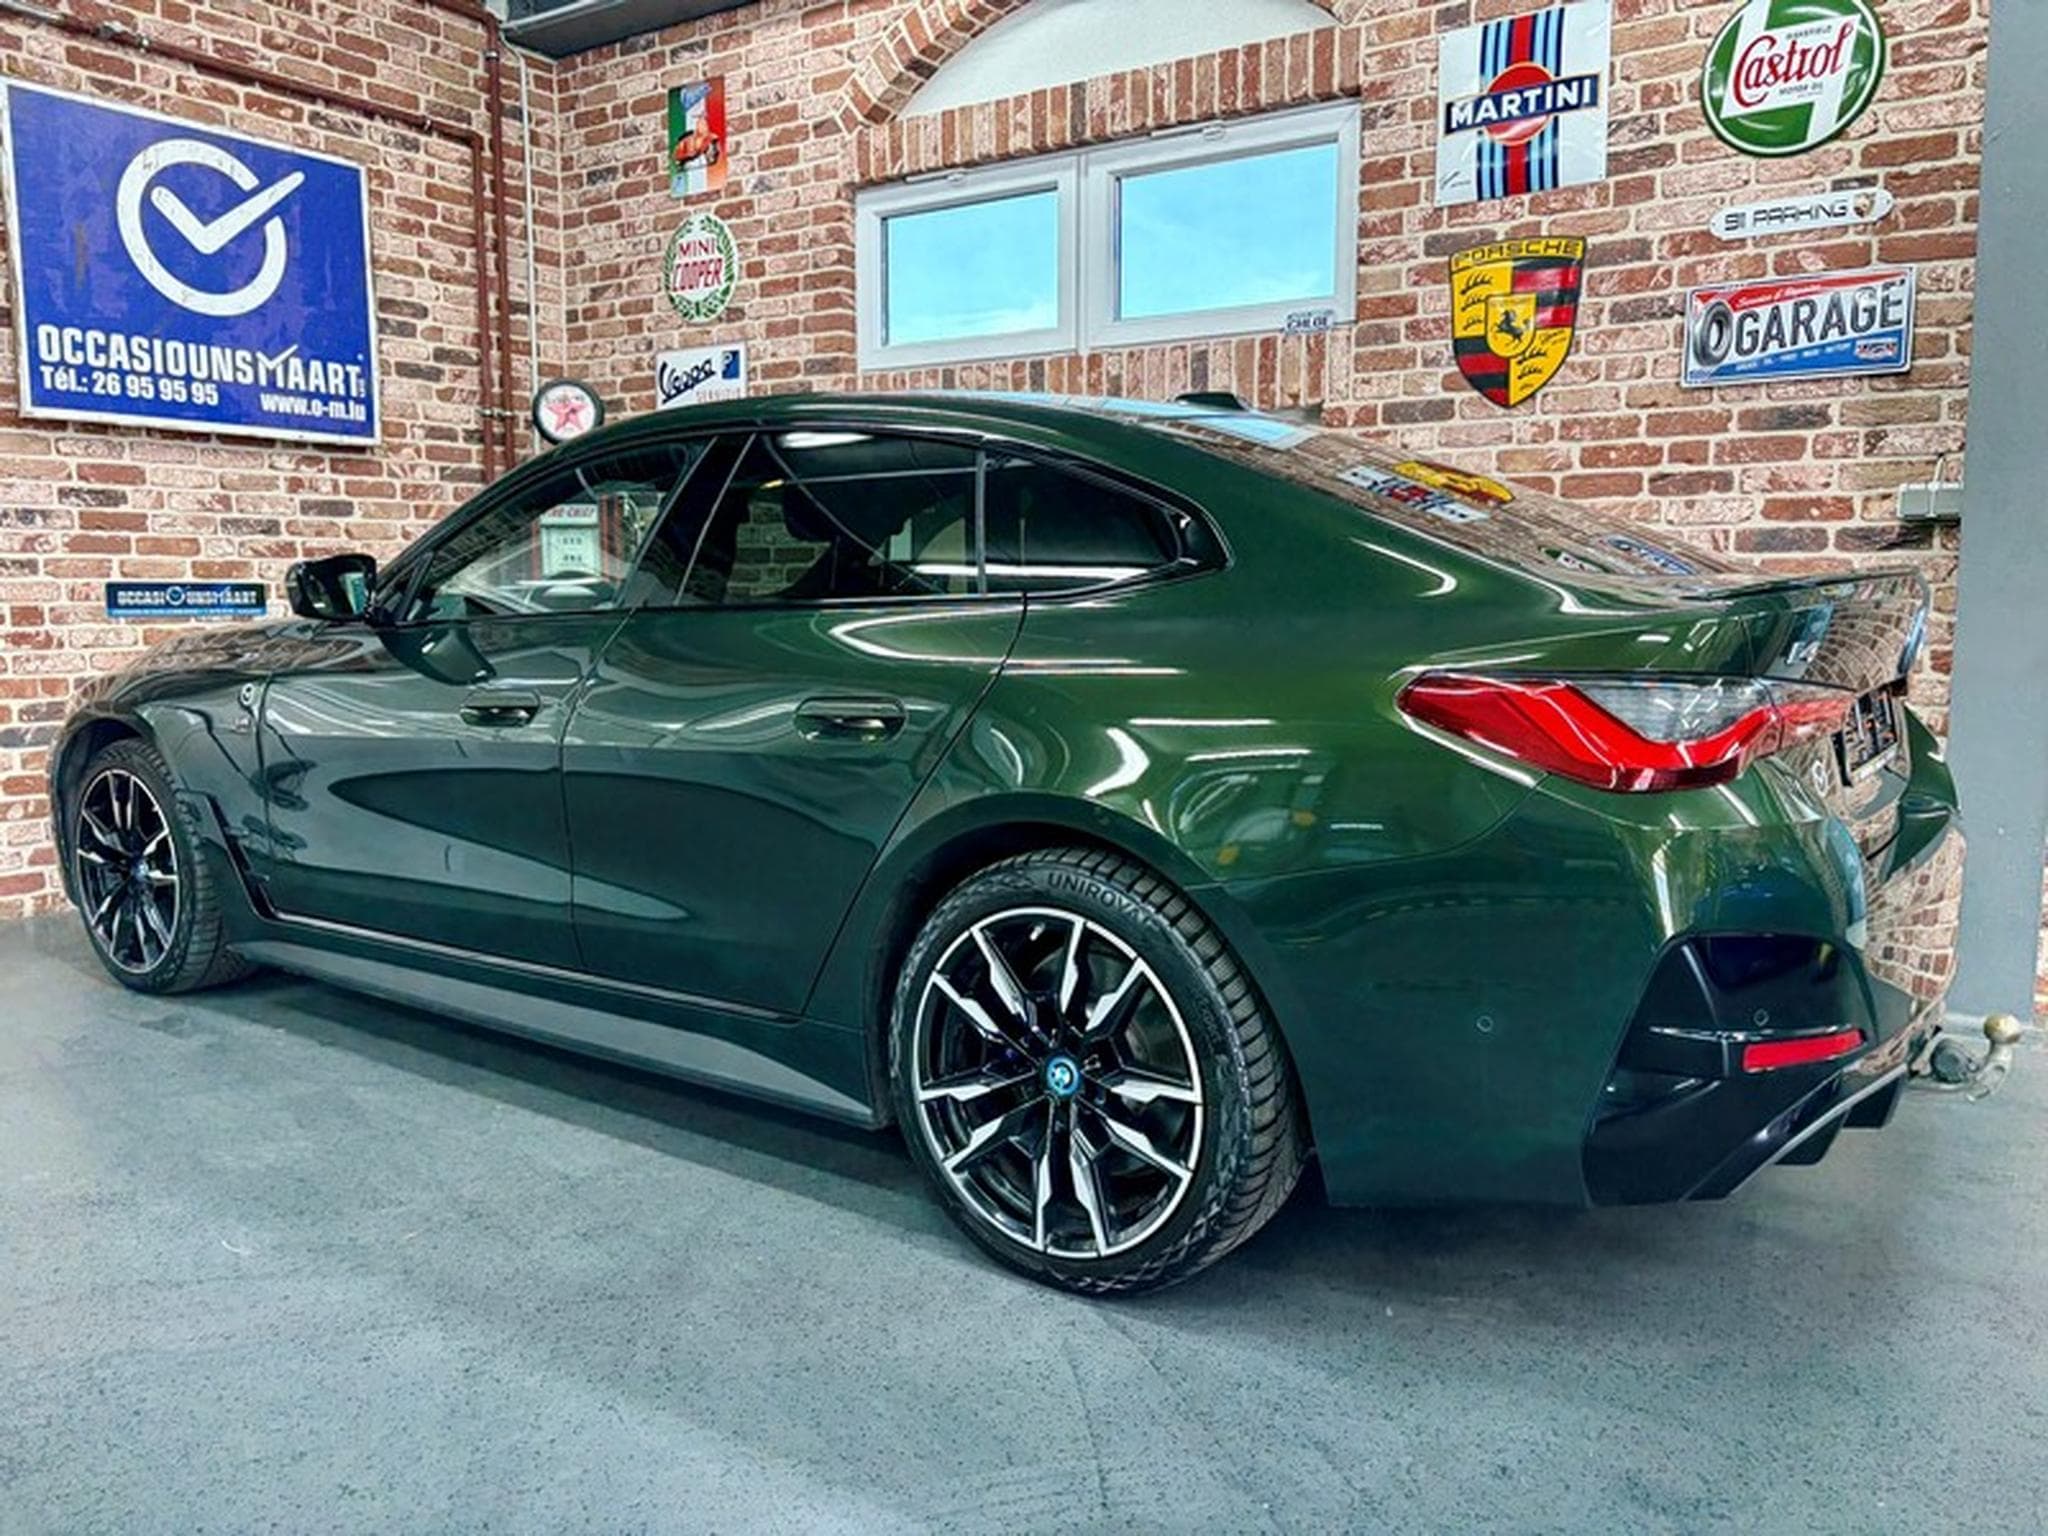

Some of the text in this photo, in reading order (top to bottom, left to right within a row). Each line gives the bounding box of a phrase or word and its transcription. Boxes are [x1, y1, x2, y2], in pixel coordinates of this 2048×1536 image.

[1732, 21, 1854, 108] Castrol
[1451, 78, 1591, 129] MARTINI
[1752, 199, 1849, 228] PARKING
[679, 238, 716, 258] MINI
[1452, 240, 1580, 267] PORSCHE
[672, 258, 723, 292] COOPER
[1735, 279, 1905, 357] GARAGE
[36, 323, 364, 398] OCCASIOUNSMAART
[91, 371, 121, 396] 26
[125, 374, 155, 399] 95
[158, 377, 187, 403] 95
[190, 381, 219, 406] 95
[659, 359, 716, 404] Vespa
[260, 392, 366, 422] www.o-m.lu
